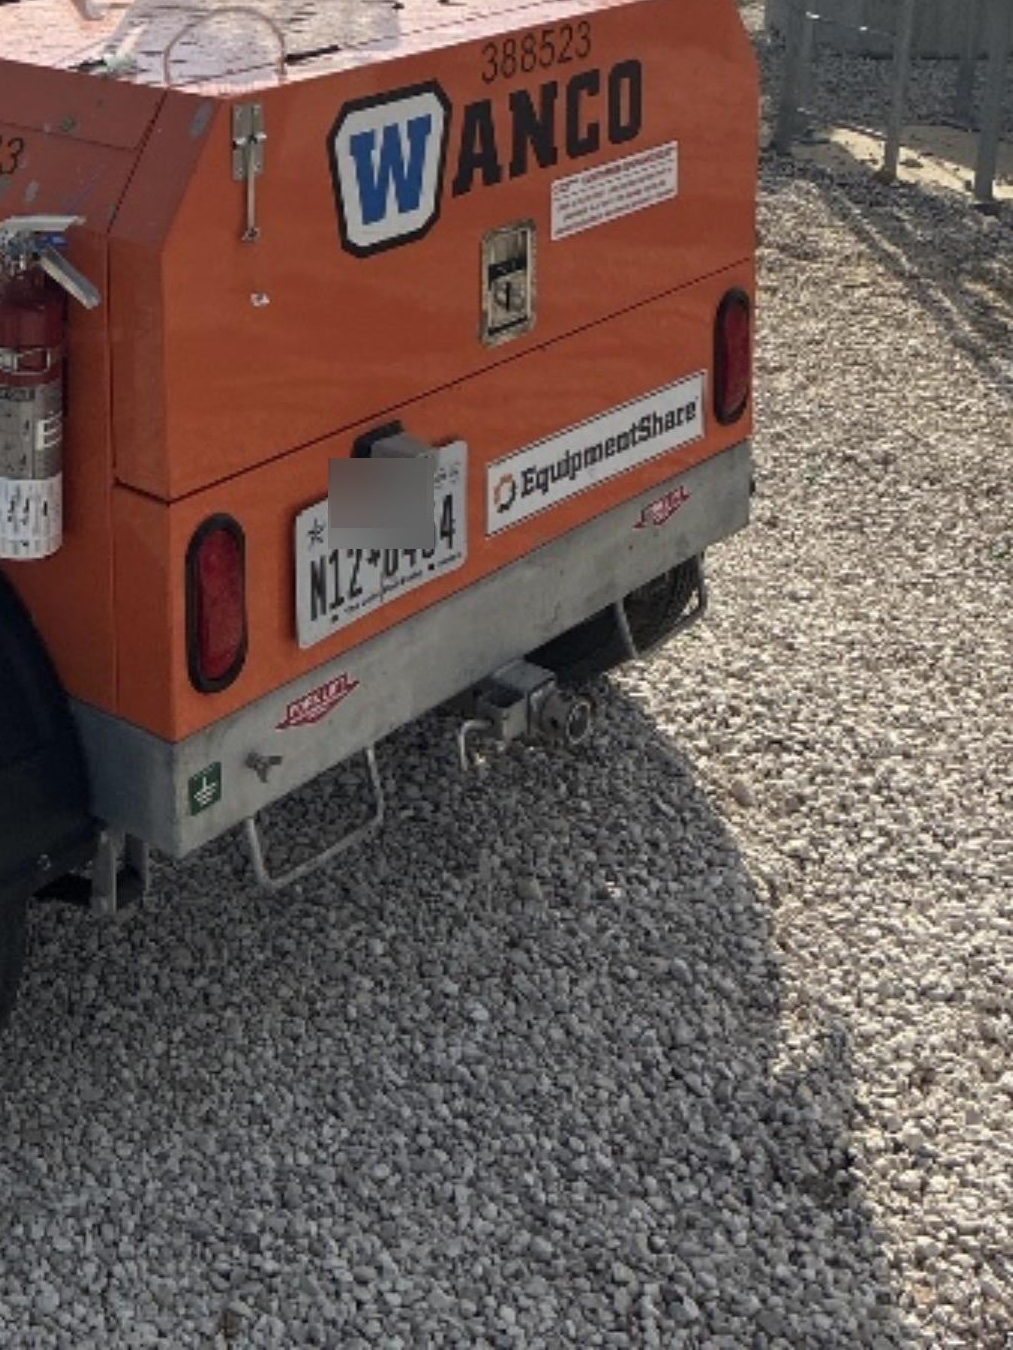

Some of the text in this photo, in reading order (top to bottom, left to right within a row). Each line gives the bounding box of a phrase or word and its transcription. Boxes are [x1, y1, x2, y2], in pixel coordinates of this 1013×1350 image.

[481, 20, 591, 84] 388523
[348, 58, 643, 227] WANCO
[520, 400, 697, 499] EquipmentShare
